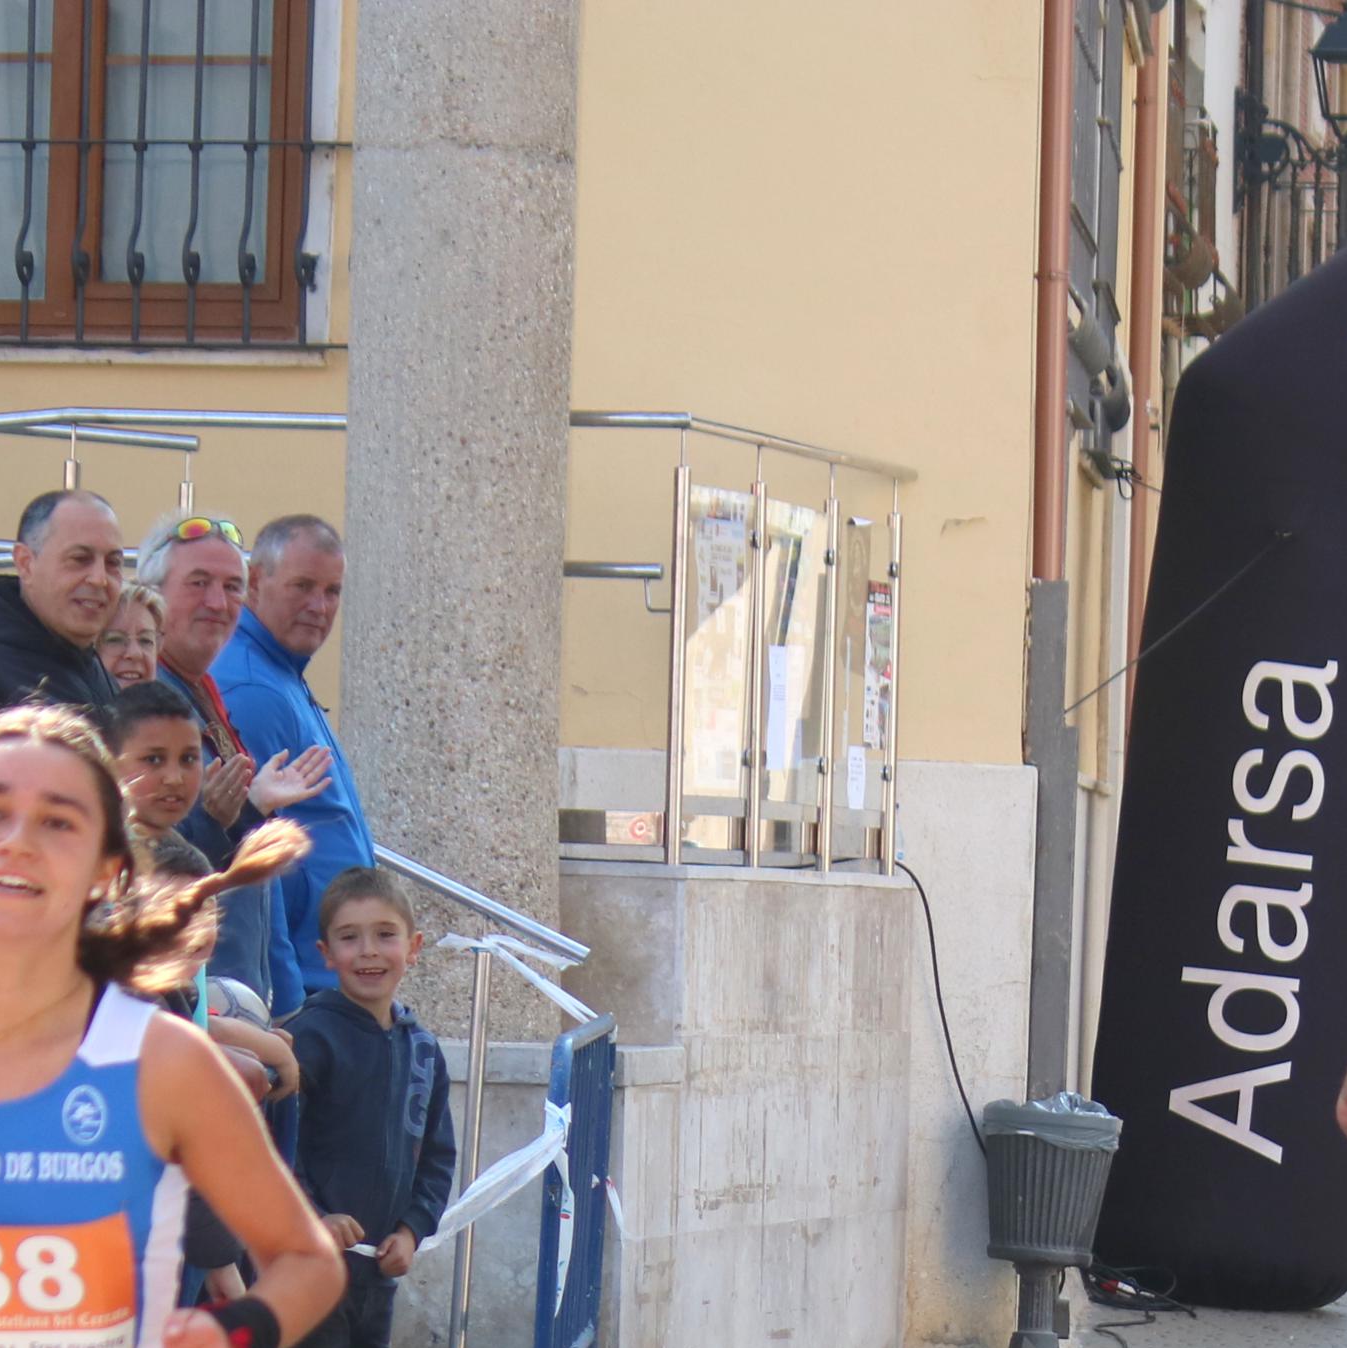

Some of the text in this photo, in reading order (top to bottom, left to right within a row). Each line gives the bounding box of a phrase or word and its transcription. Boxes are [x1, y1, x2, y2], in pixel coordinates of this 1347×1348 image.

[1168, 660, 1339, 1164] Adarsa
[4, 1151, 32, 1180] DE
[38, 1150, 124, 1181] BURGOS
